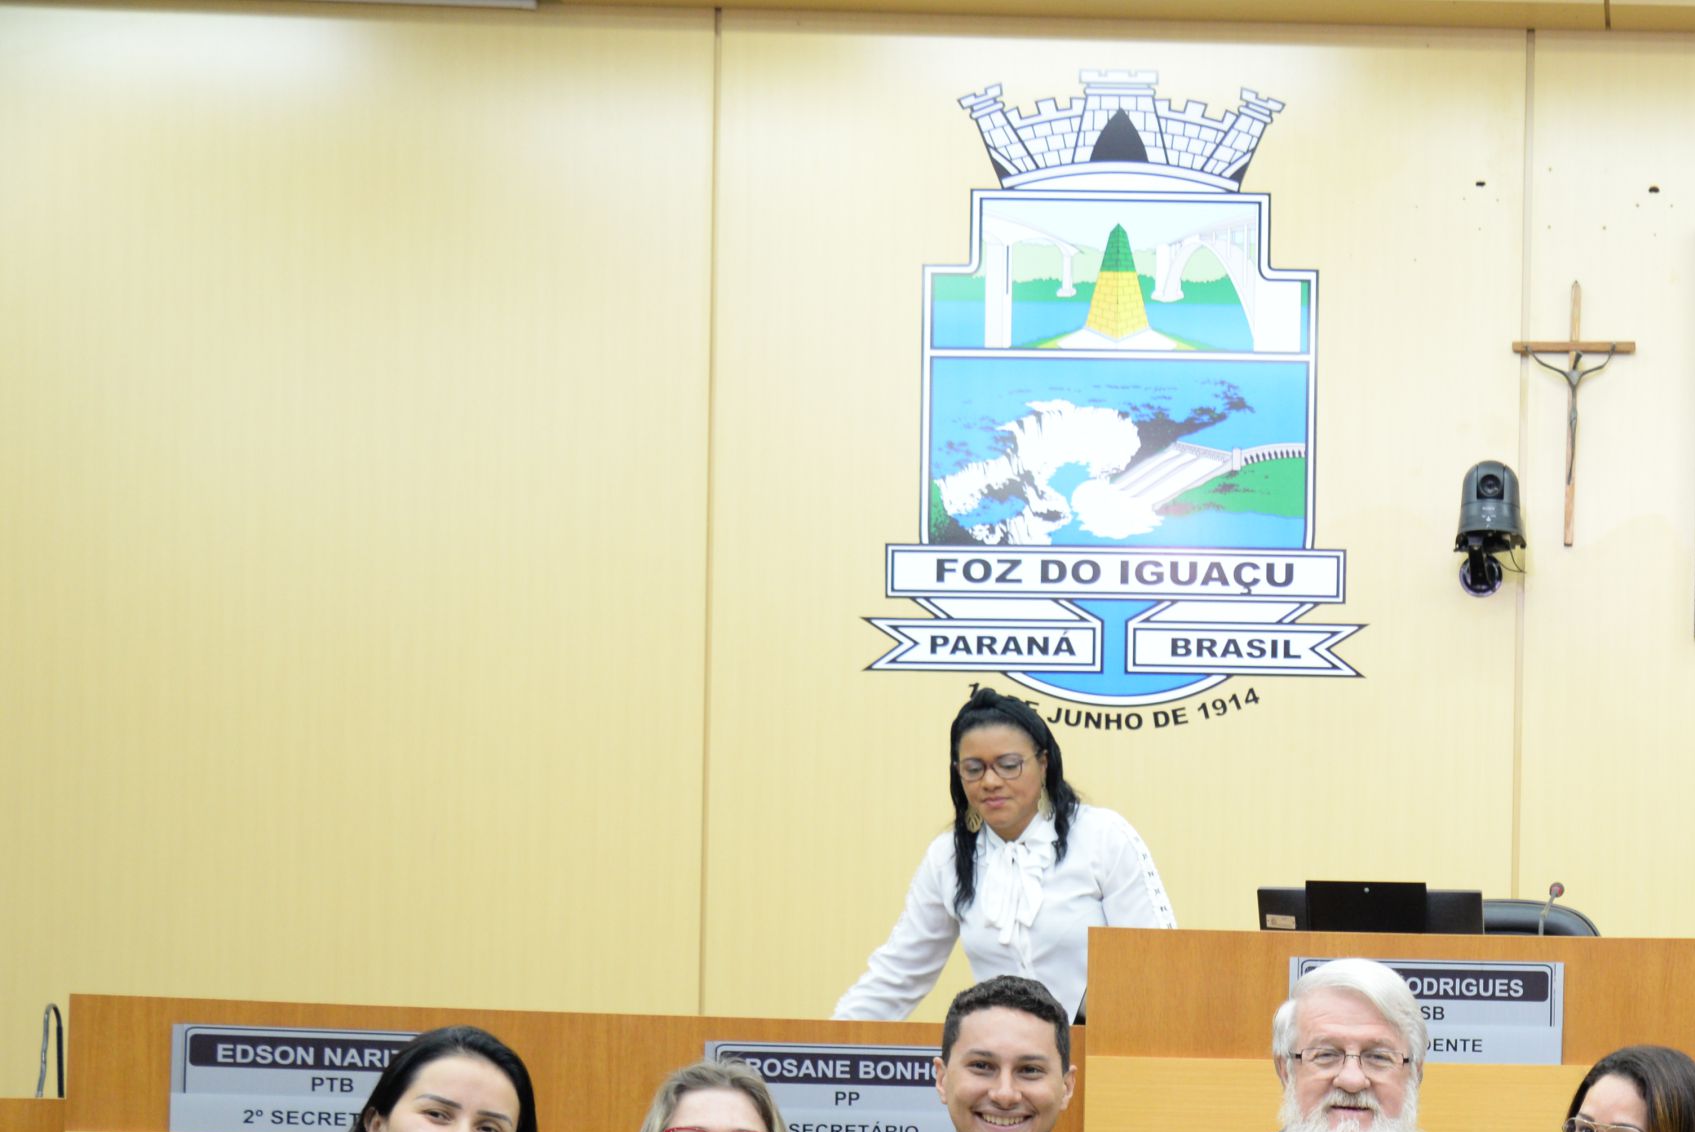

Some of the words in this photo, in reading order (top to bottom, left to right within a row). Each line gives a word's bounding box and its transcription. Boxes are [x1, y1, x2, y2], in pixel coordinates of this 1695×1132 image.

[936, 558, 1022, 584] FOZ
[1040, 560, 1101, 586] DO
[1120, 560, 1295, 595] IGUAÇU
[929, 631, 1077, 656] PARANÁ
[1170, 637, 1302, 659] BRASIL
[1046, 706, 1144, 731] JUNHO
[1153, 708, 1190, 727] DE
[1197, 688, 1260, 721] 1914
[1405, 976, 1524, 998] ODRIGUES
[1420, 1005, 1446, 1021] SB
[216, 1043, 315, 1066] EDSON
[323, 1046, 399, 1068] NARI
[311, 1076, 355, 1094] PTB
[834, 1091, 861, 1107] PP
[271, 1109, 360, 1128] SECRET
